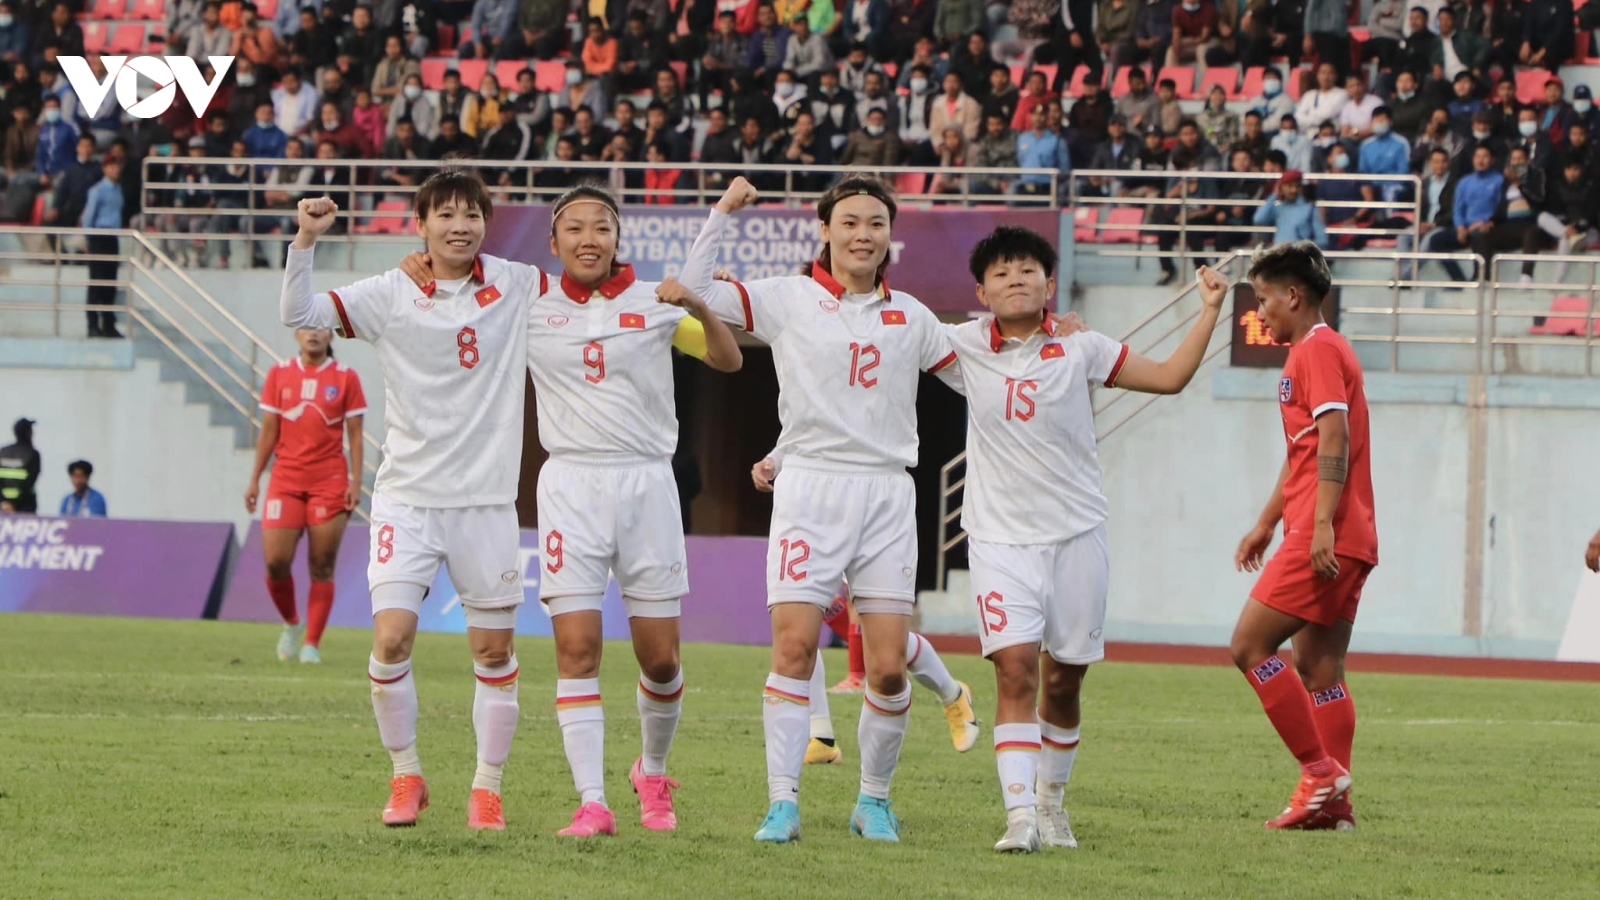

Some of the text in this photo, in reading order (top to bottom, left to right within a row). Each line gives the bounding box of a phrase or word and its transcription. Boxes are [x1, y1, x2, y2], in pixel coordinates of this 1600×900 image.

[745, 218, 821, 240] OLYM
[457, 326, 480, 370] 8
[583, 340, 606, 384] 9
[849, 342, 881, 389] 12
[301, 379, 317, 400] 10
[1005, 377, 1037, 422] 15
[377, 523, 395, 564] 8
[546, 530, 563, 574] 9
[779, 538, 811, 582] 12
[977, 591, 1008, 637] 15
